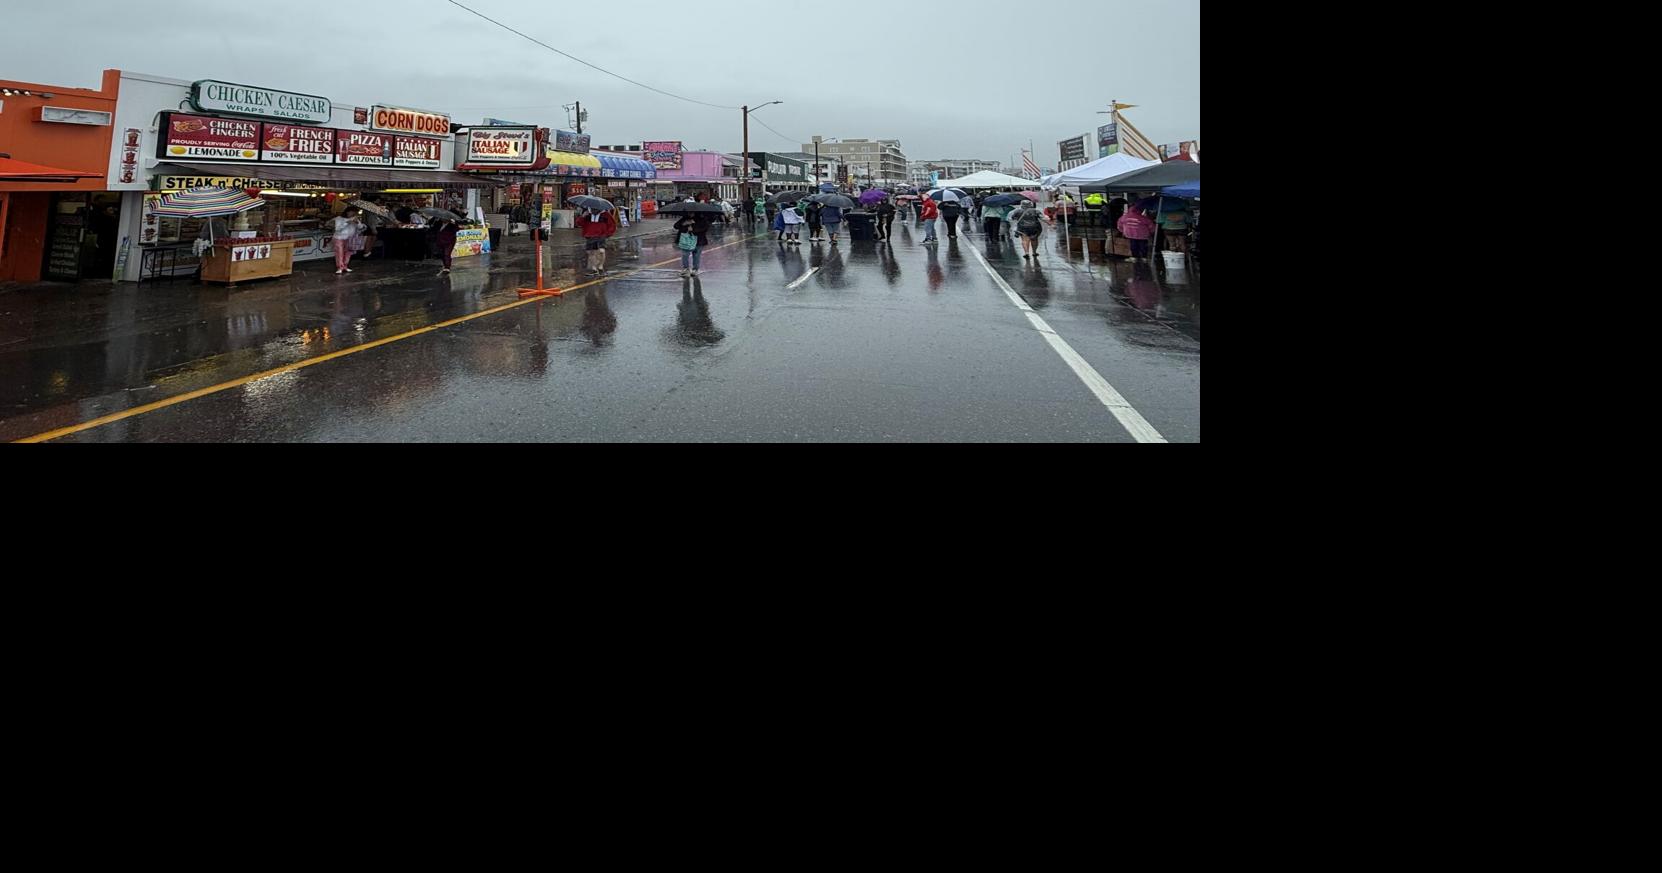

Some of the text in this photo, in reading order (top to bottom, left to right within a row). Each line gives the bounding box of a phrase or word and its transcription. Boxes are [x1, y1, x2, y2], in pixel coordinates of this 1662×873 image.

[207, 84, 326, 114] CHICKEN CAESAR
[226, 104, 310, 119] WRAPS SALADS
[209, 120, 256, 131] CHICKEN
[376, 110, 448, 134] CORN DOGS
[210, 128, 255, 138] FINGERS
[269, 126, 287, 134] fresh
[290, 128, 332, 140] FRENCH
[350, 134, 381, 146] PIZZA
[472, 140, 510, 148] ITALIAN
[289, 139, 332, 153] FRIES
[396, 141, 427, 152] ITALIAN
[188, 147, 241, 158] LEMONADE
[290, 152, 317, 160] Vegetable
[396, 150, 427, 159] SAUSAGE
[349, 155, 381, 164] CALZONES
[166, 177, 213, 189] STEAK
[234, 178, 280, 189] CHEESE
